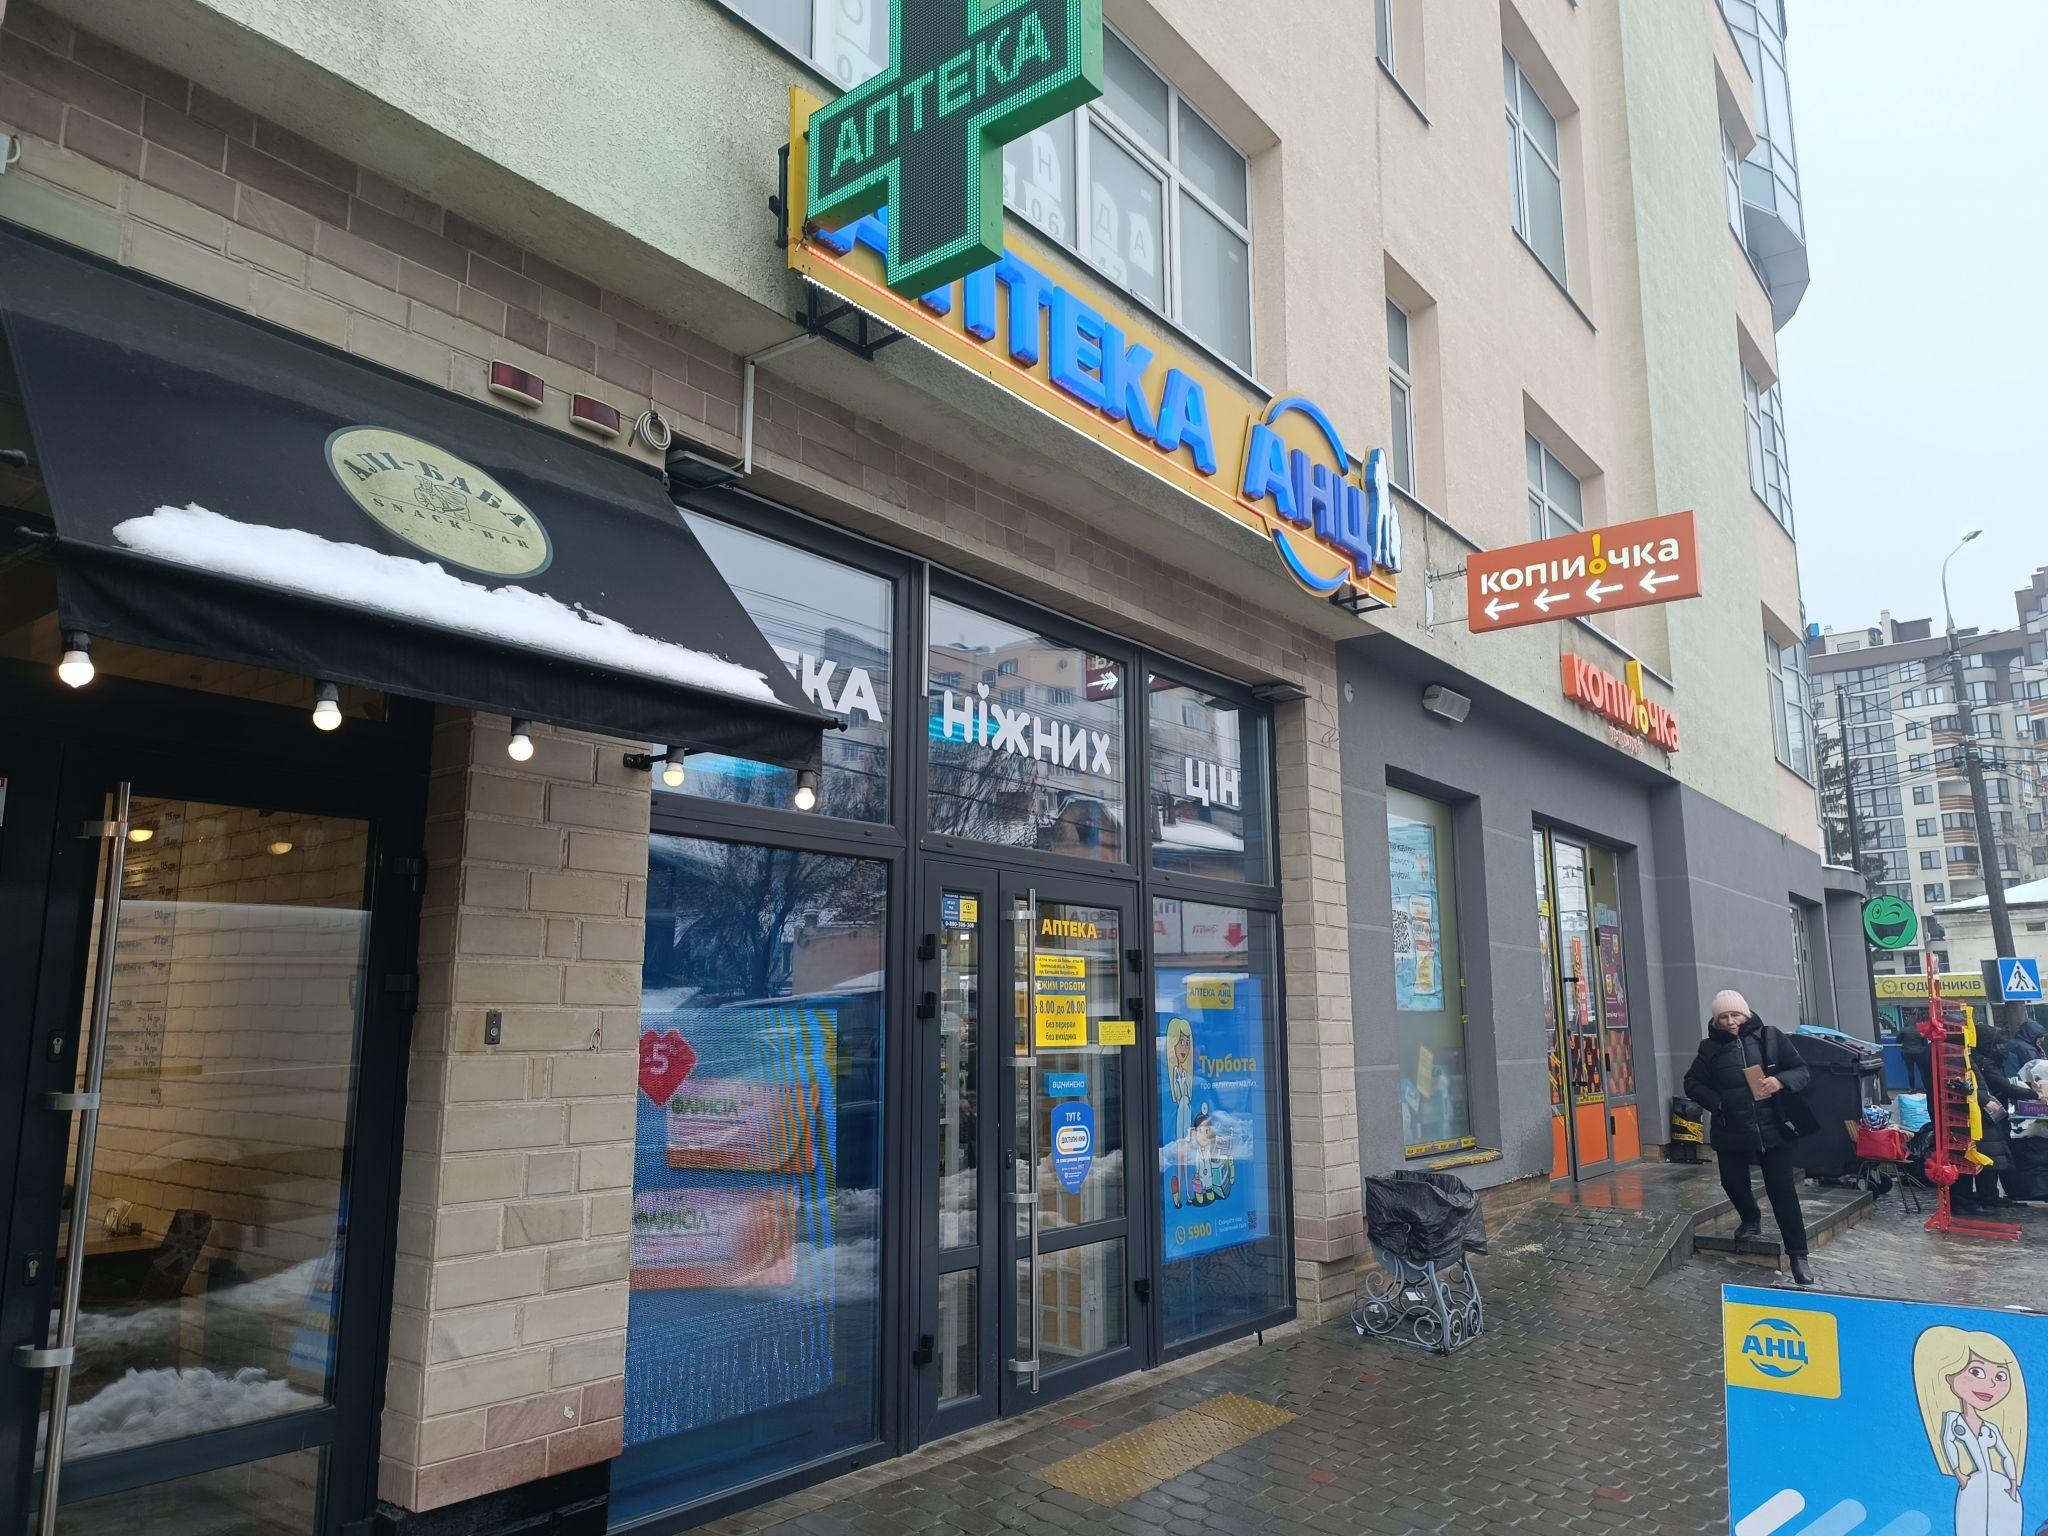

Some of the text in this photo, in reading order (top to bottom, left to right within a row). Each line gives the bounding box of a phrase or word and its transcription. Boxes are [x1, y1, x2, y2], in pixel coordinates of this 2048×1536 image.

[830, 11, 1051, 178] АПТЕКА
[343, 452, 526, 528] АЛІ-БАБА
[1242, 422, 1374, 579] АНЦ
[372, 497, 530, 550] SNACK-BAR
[1041, 918, 1098, 939] АПТЕКА
[1059, 981, 1086, 992] РОБОТИ
[1190, 988, 1233, 999] АПТЕКА АНЦ
[1039, 1000, 1055, 1014] 8.00
[1056, 1005, 1065, 1016] до
[1066, 1000, 1086, 1015] 20.00
[1045, 1020, 1055, 1029] без
[1045, 1031, 1055, 1041] без
[1199, 1053, 1257, 1078] Турбота
[1052, 1081, 1085, 1090] ВІДЧИНЕНО
[1065, 1111, 1076, 1122] ТУТ
[1188, 1222, 1213, 1240] 5900
[1742, 1334, 1810, 1366] АНЦ
